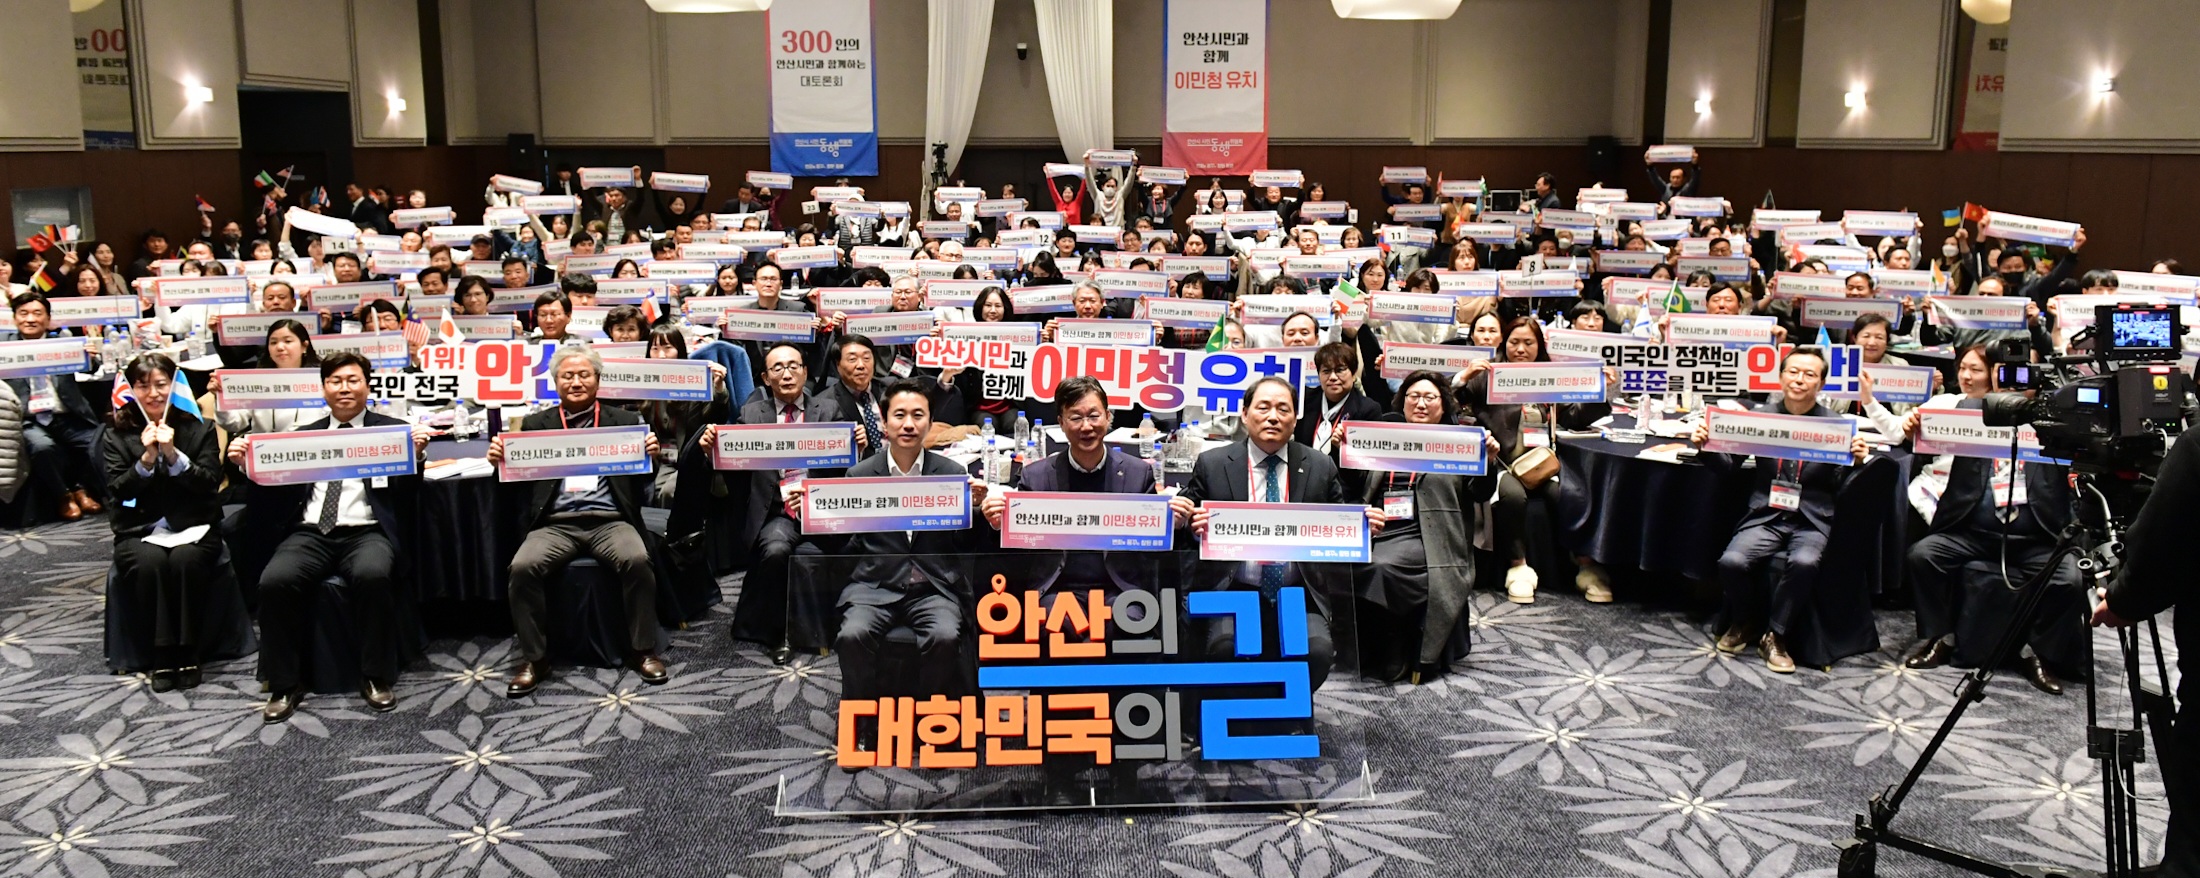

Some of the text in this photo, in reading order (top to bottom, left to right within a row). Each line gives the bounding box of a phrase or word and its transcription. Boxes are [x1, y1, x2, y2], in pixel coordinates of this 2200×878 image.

[782, 30, 860, 53] 300 인의
[1183, 32, 1249, 46] 안산시민과
[1203, 50, 1229, 63] 함께
[776, 60, 866, 69] 안산시민과 함께하는
[801, 76, 843, 86] 대토론회
[1175, 71, 1256, 89] 이민청 유치
[1039, 235, 1049, 243] 12
[1391, 232, 1401, 240] 11
[1529, 261, 1535, 273] 8
[420, 348, 464, 370] 1위!
[918, 338, 1027, 370] 안산시민과
[1602, 346, 1739, 368] 외국인 정책의
[1390, 356, 1426, 364] 안산시민과
[1447, 359, 1469, 367] 이민청
[662, 375, 685, 383] 이민청
[687, 376, 702, 384] 유치
[985, 374, 1024, 398] 함께
[1032, 345, 1302, 416] 이민청 유치
[1498, 377, 1595, 386] 안산시민과 함께 이민청 유치
[1623, 370, 1737, 392] 표준을 만든
[227, 385, 270, 393] 안산시민과
[293, 384, 318, 392] 이민청
[370, 376, 459, 398] 국인 전국
[1715, 425, 1845, 445] 안산시민과 함께 이민청 유치
[2018, 432, 2036, 441] 이민
[511, 444, 640, 461] 안산시민과 함께 이민청 유치
[724, 440, 845, 451] 안산시민과 함께 이민청 유치
[1352, 439, 1474, 454] 안산시민과 함께 이민청 유치
[260, 445, 401, 464] 안산시민과 함께 이민청 유치
[816, 495, 957, 509] 안산시민과 함께 이민청 유치
[1016, 514, 1160, 527] 안산시민과 함께 이민청 유치
[1215, 523, 1356, 537] 안산시민과 함께 이민청 유치
[976, 574, 1178, 659] 안산의
[837, 691, 1181, 768] 대한민국의
